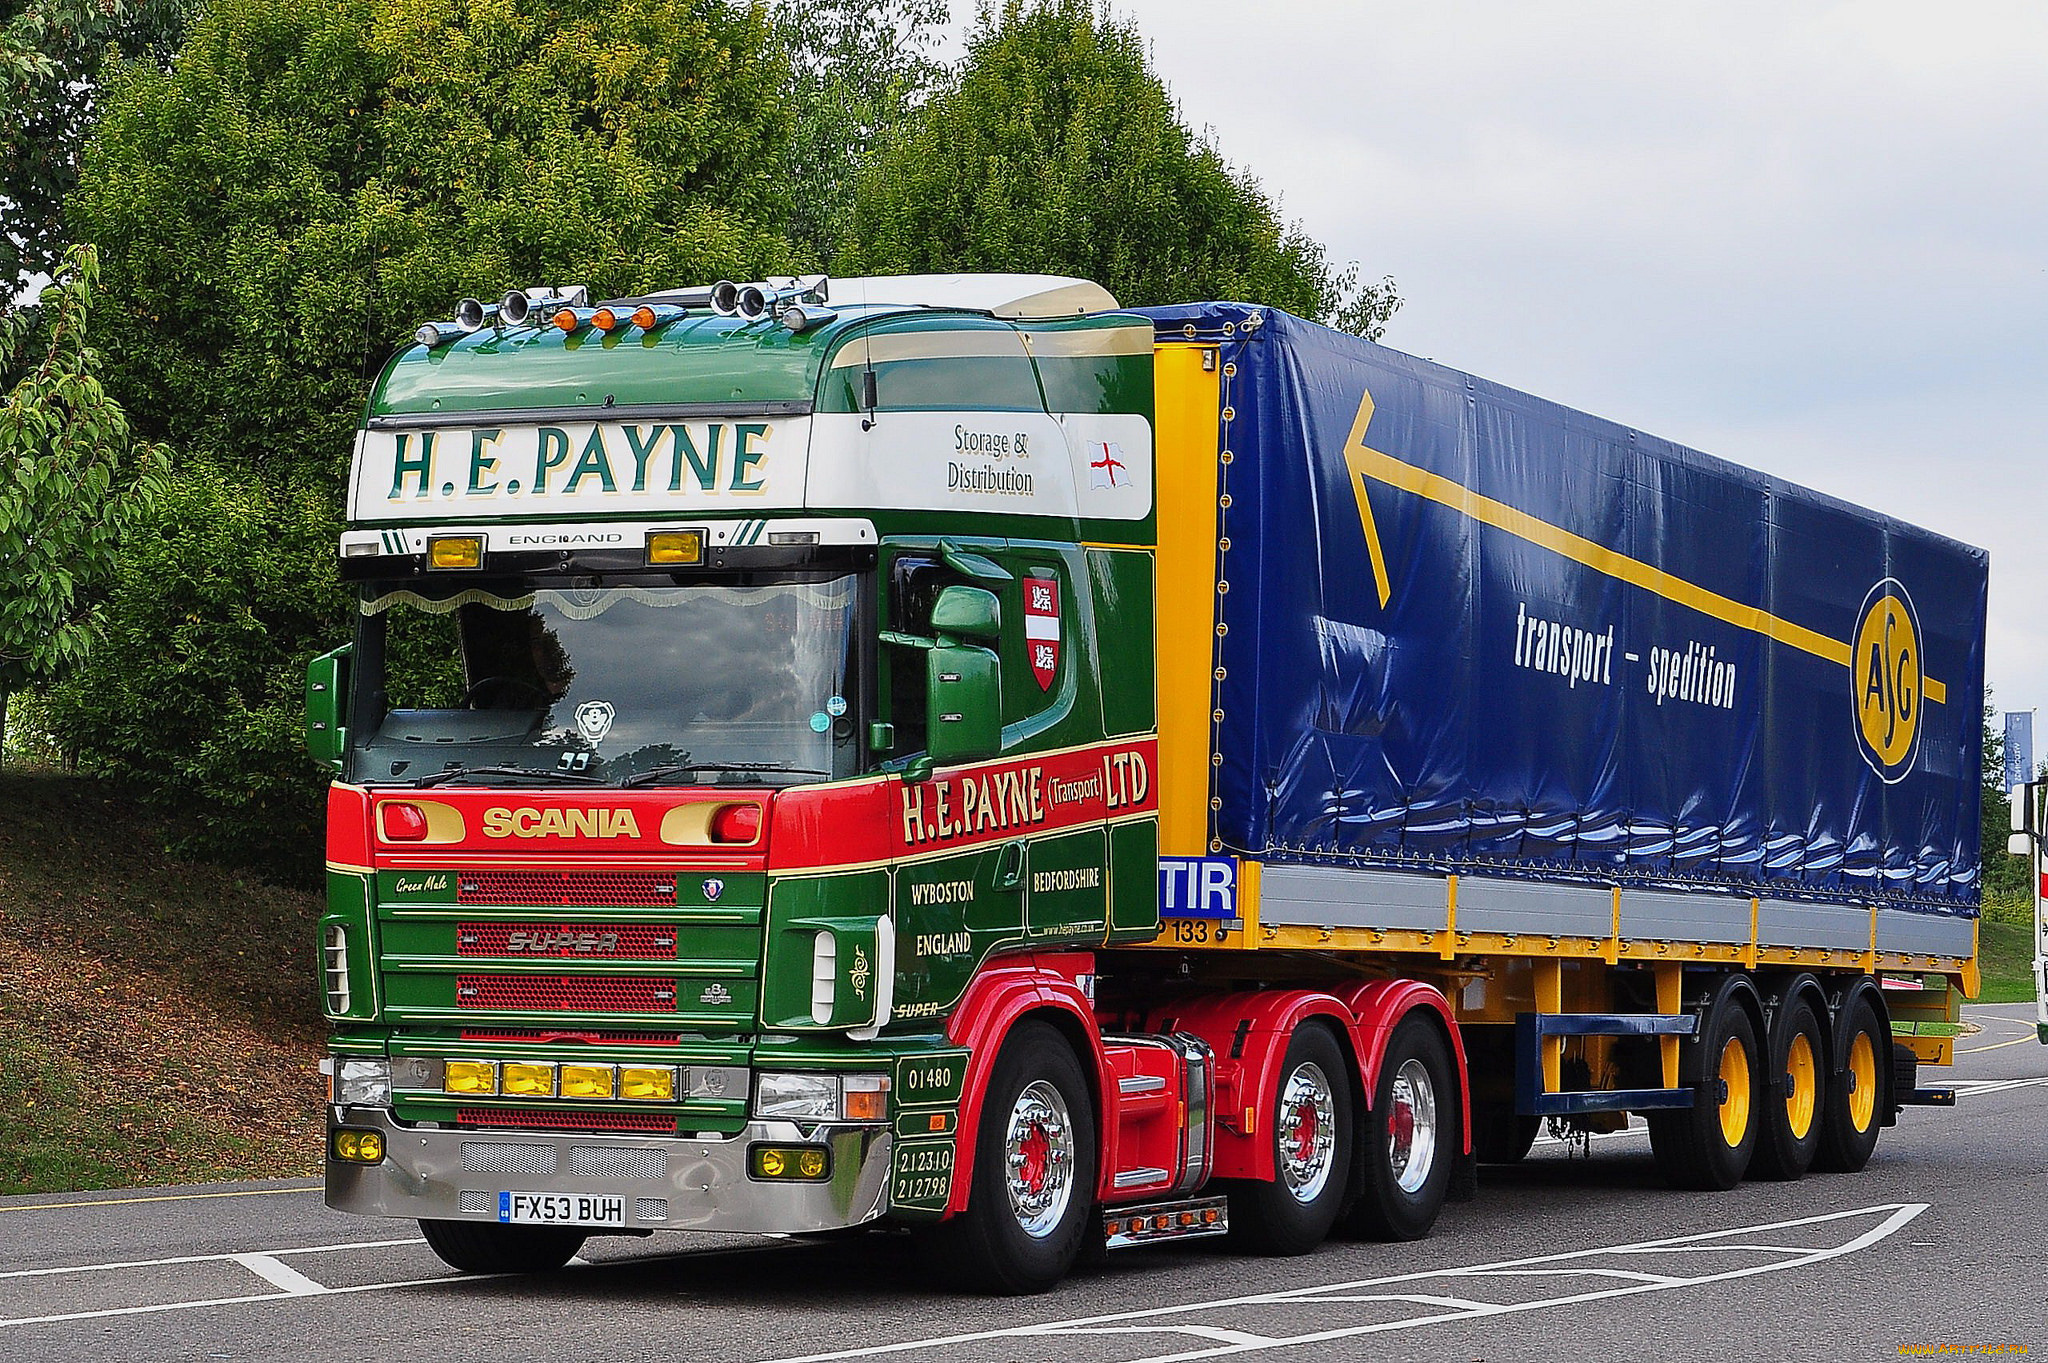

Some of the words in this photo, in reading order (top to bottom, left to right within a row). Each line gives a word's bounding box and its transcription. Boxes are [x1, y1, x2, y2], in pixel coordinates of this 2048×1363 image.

[954, 424, 1009, 457] Storage
[1013, 432, 1029, 456] &
[948, 462, 1034, 495] Distribution
[509, 533, 622, 544] ENGLAND
[1514, 602, 1614, 689] transport
[1648, 640, 1736, 709] spedition
[1865, 612, 1912, 749] ASG
[1048, 767, 1103, 810] (Transport)
[1103, 751, 1150, 810] LTD
[482, 807, 641, 838] SCANIA
[910, 880, 975, 906] WYBOSTON
[1033, 867, 1100, 893] BEDFORDSHIRE
[1159, 862, 1233, 910] TIR
[507, 932, 619, 952] SUPER
[916, 932, 972, 956] ENGLAND
[1171, 920, 1209, 943] 133
[897, 1001, 939, 1018] SUPER
[908, 1067, 951, 1089] 01480
[900, 1150, 950, 1173] 212310
[897, 1176, 947, 1199] 212798
[514, 1196, 571, 1220] FX53
[578, 1198, 622, 1222] BUH
